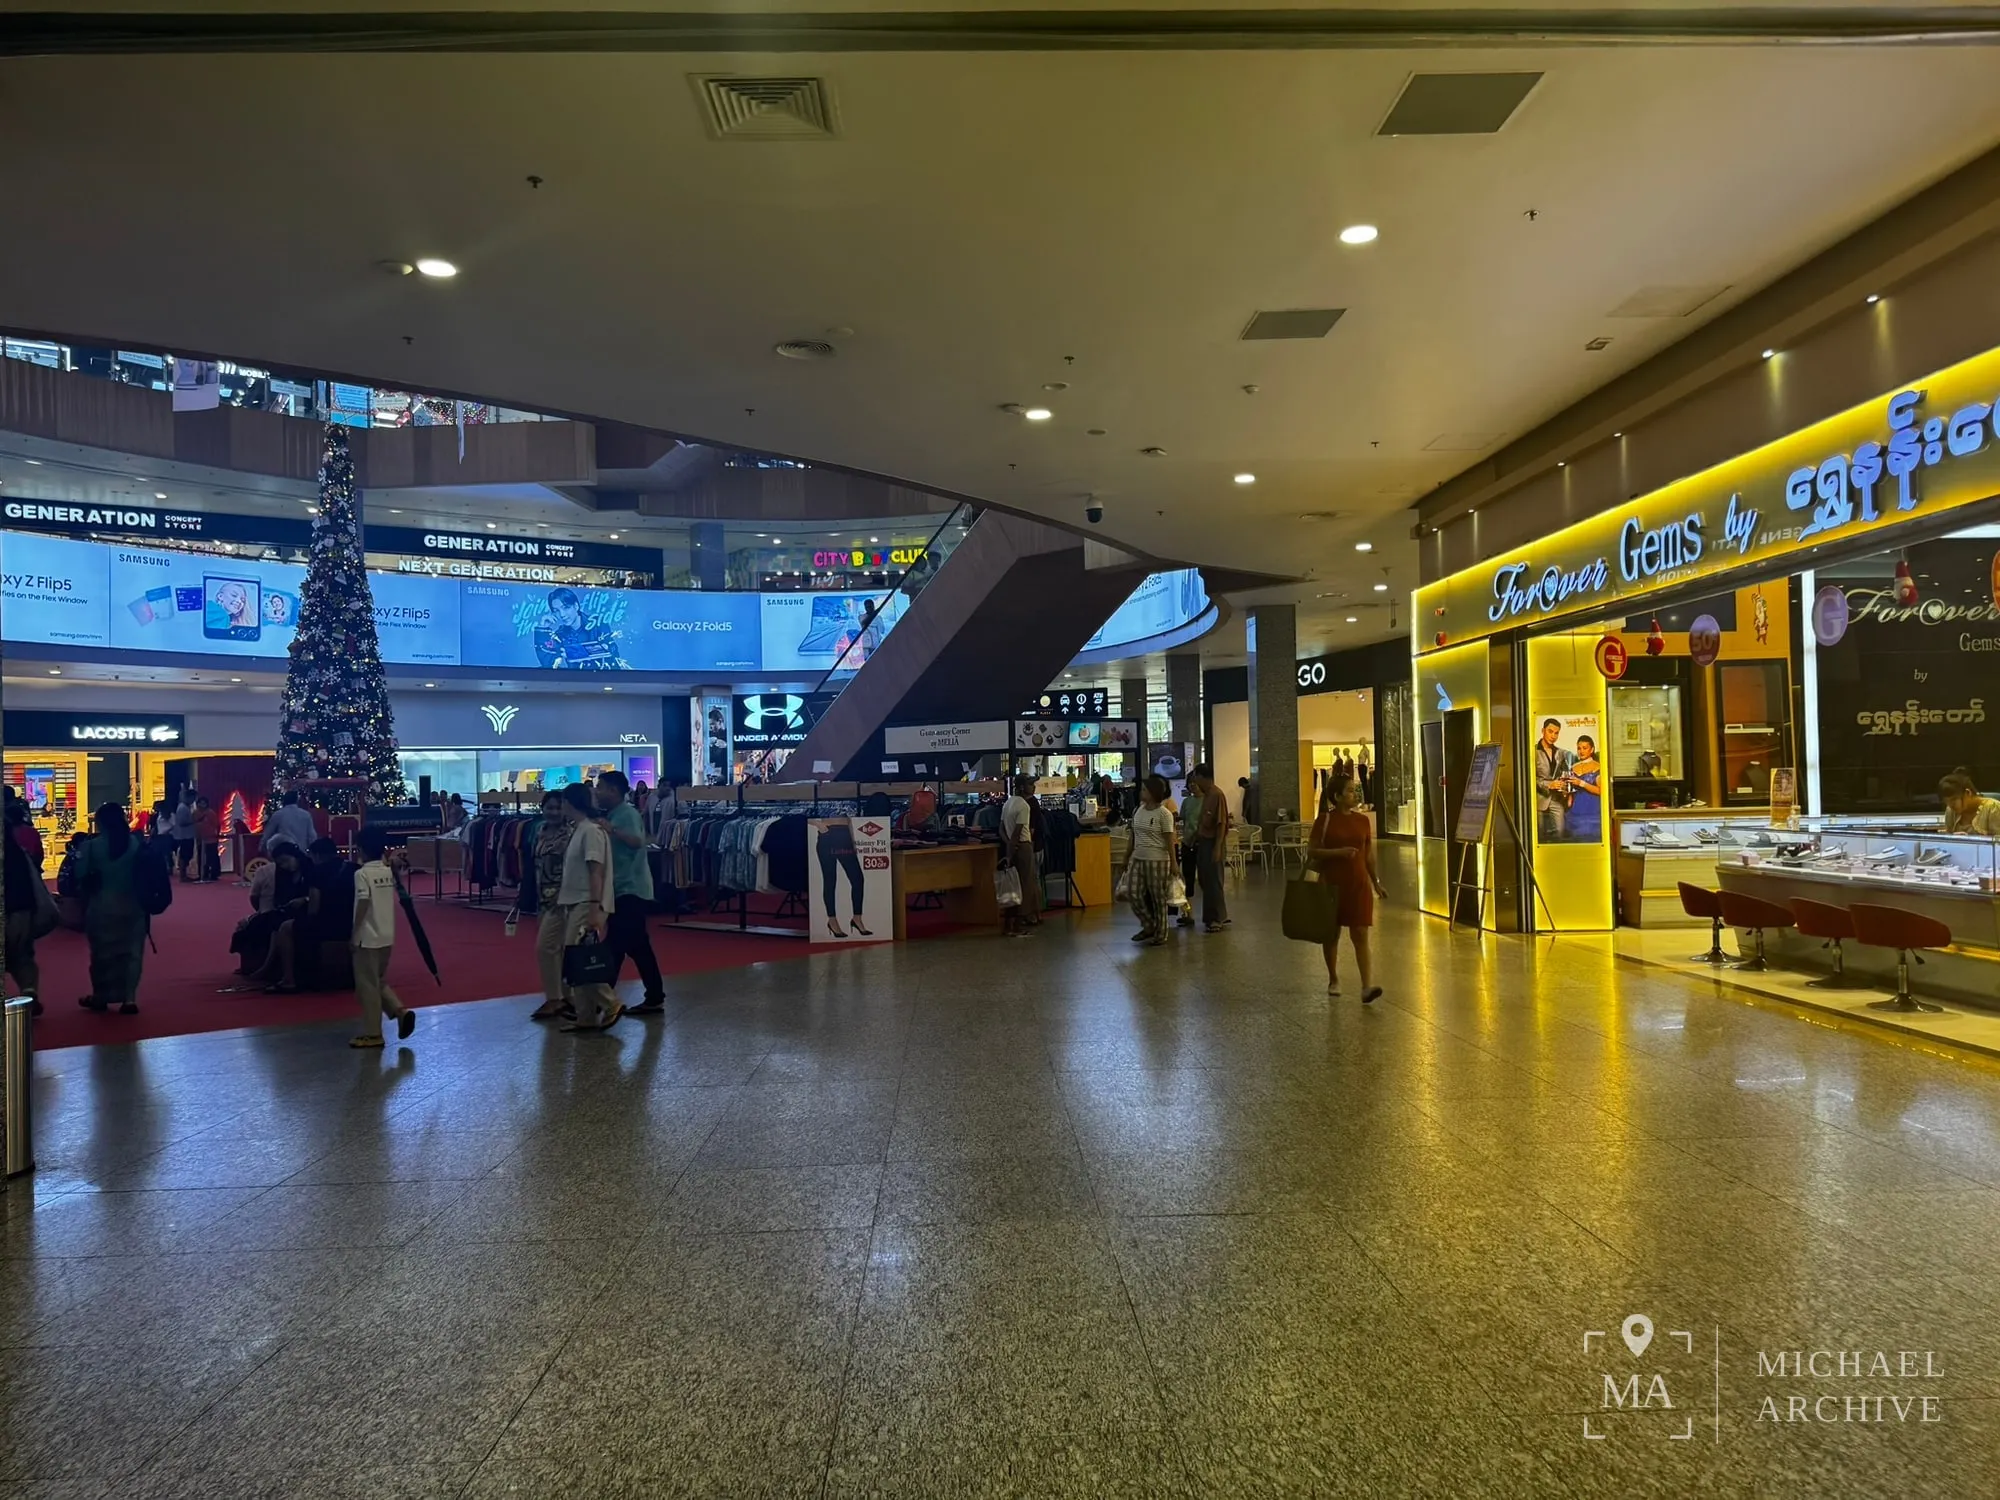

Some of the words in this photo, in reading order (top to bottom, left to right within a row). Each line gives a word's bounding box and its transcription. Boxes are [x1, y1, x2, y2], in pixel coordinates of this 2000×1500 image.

[5, 503, 156, 527] GENERATION
[424, 534, 539, 555] GENERATION
[1620, 517, 1705, 581] Gems
[1725, 494, 1759, 554] by
[119, 553, 170, 567] SAMSUNG
[814, 551, 848, 567] CITY
[399, 560, 444, 574] NEXT
[450, 562, 554, 580] GENERATION
[25, 575, 34, 587] Z
[38, 576, 72, 593] Flip5
[467, 586, 510, 597] SAMSUNG
[58, 596, 88, 605] Window
[581, 591, 609, 613] flip
[393, 607, 400, 617] Z
[402, 608, 430, 621] Flip5
[653, 620, 694, 633] Galaxy
[694, 621, 701, 631] Z
[702, 621, 732, 632] Fold5
[1959, 632, 2000, 652] Gems
[1597, 641, 1625, 675] G
[1297, 662, 1326, 687] GO
[1913, 669, 1929, 683] by
[73, 726, 146, 740] LACOSTE
[620, 733, 648, 743] NETA
[734, 734, 769, 742] UNDER
[865, 858, 877, 869] 30
